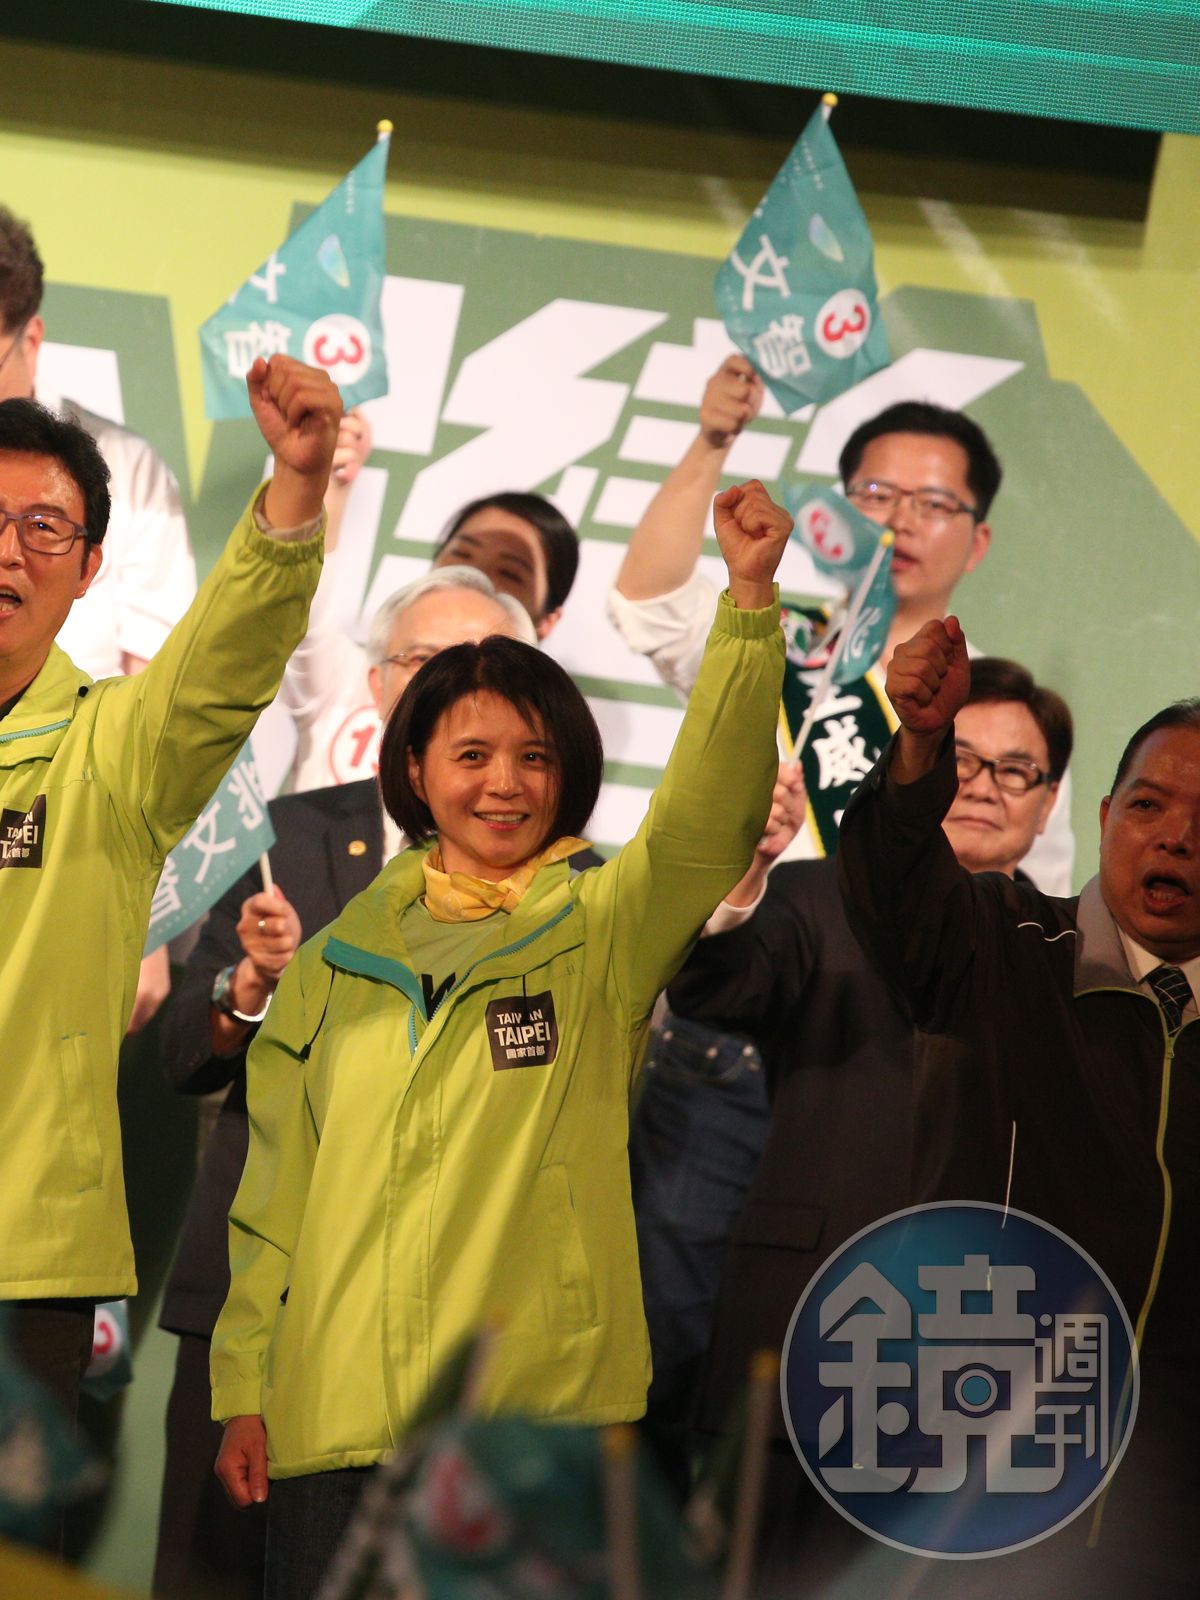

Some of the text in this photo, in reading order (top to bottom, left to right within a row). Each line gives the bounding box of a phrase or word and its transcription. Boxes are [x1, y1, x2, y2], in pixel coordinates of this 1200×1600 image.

[822, 303, 868, 342] 3
[312, 334, 364, 367] 3
[493, 1021, 552, 1047] TAIPEI
